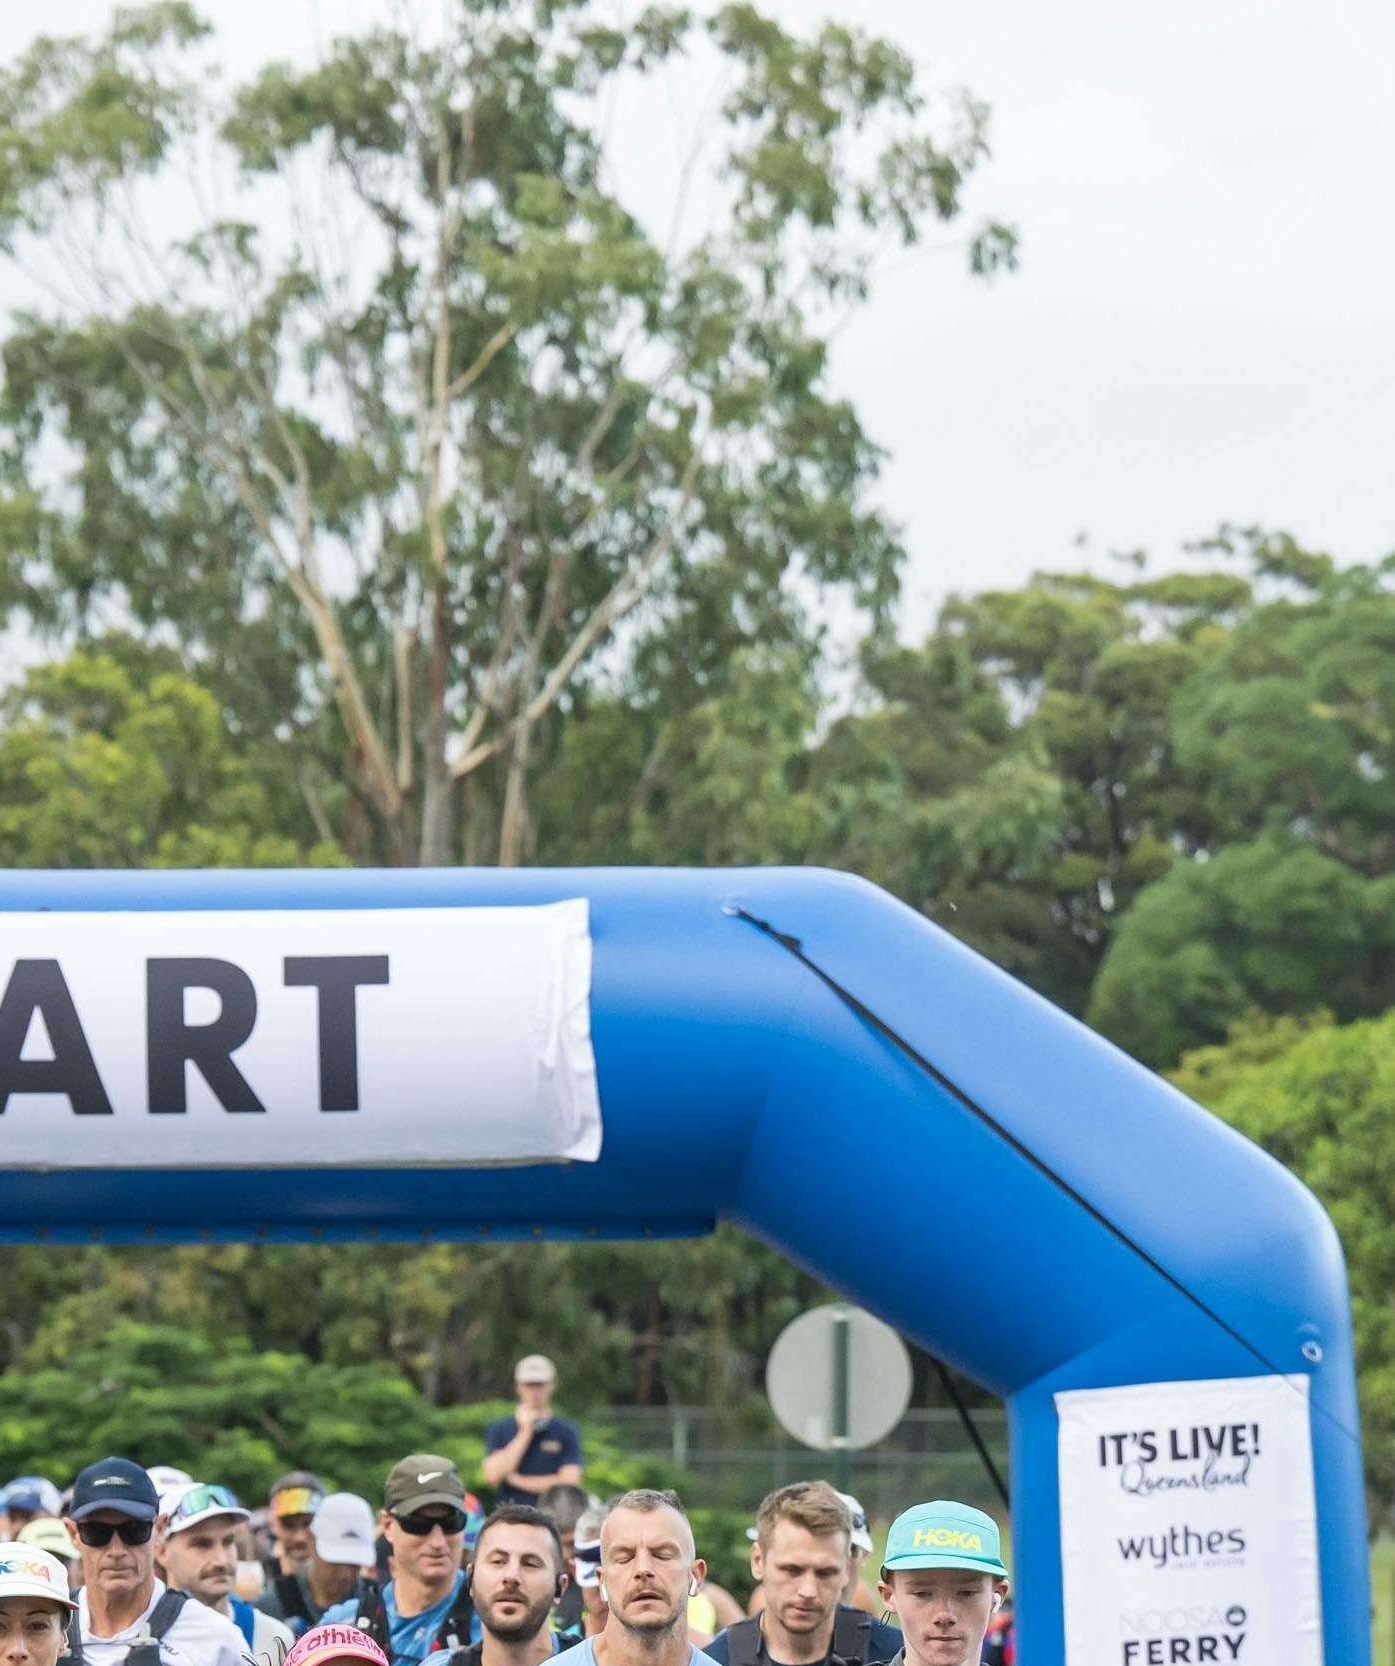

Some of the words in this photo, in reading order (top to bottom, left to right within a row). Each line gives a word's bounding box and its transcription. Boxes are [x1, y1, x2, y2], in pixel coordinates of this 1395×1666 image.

[1100, 1431, 1158, 1467] IT'S
[1170, 1423, 1260, 1460] LIVE!
[1120, 1450, 1251, 1496] Queensland
[912, 1527, 983, 1553] HOKA
[1118, 1524, 1245, 1568] wythes
